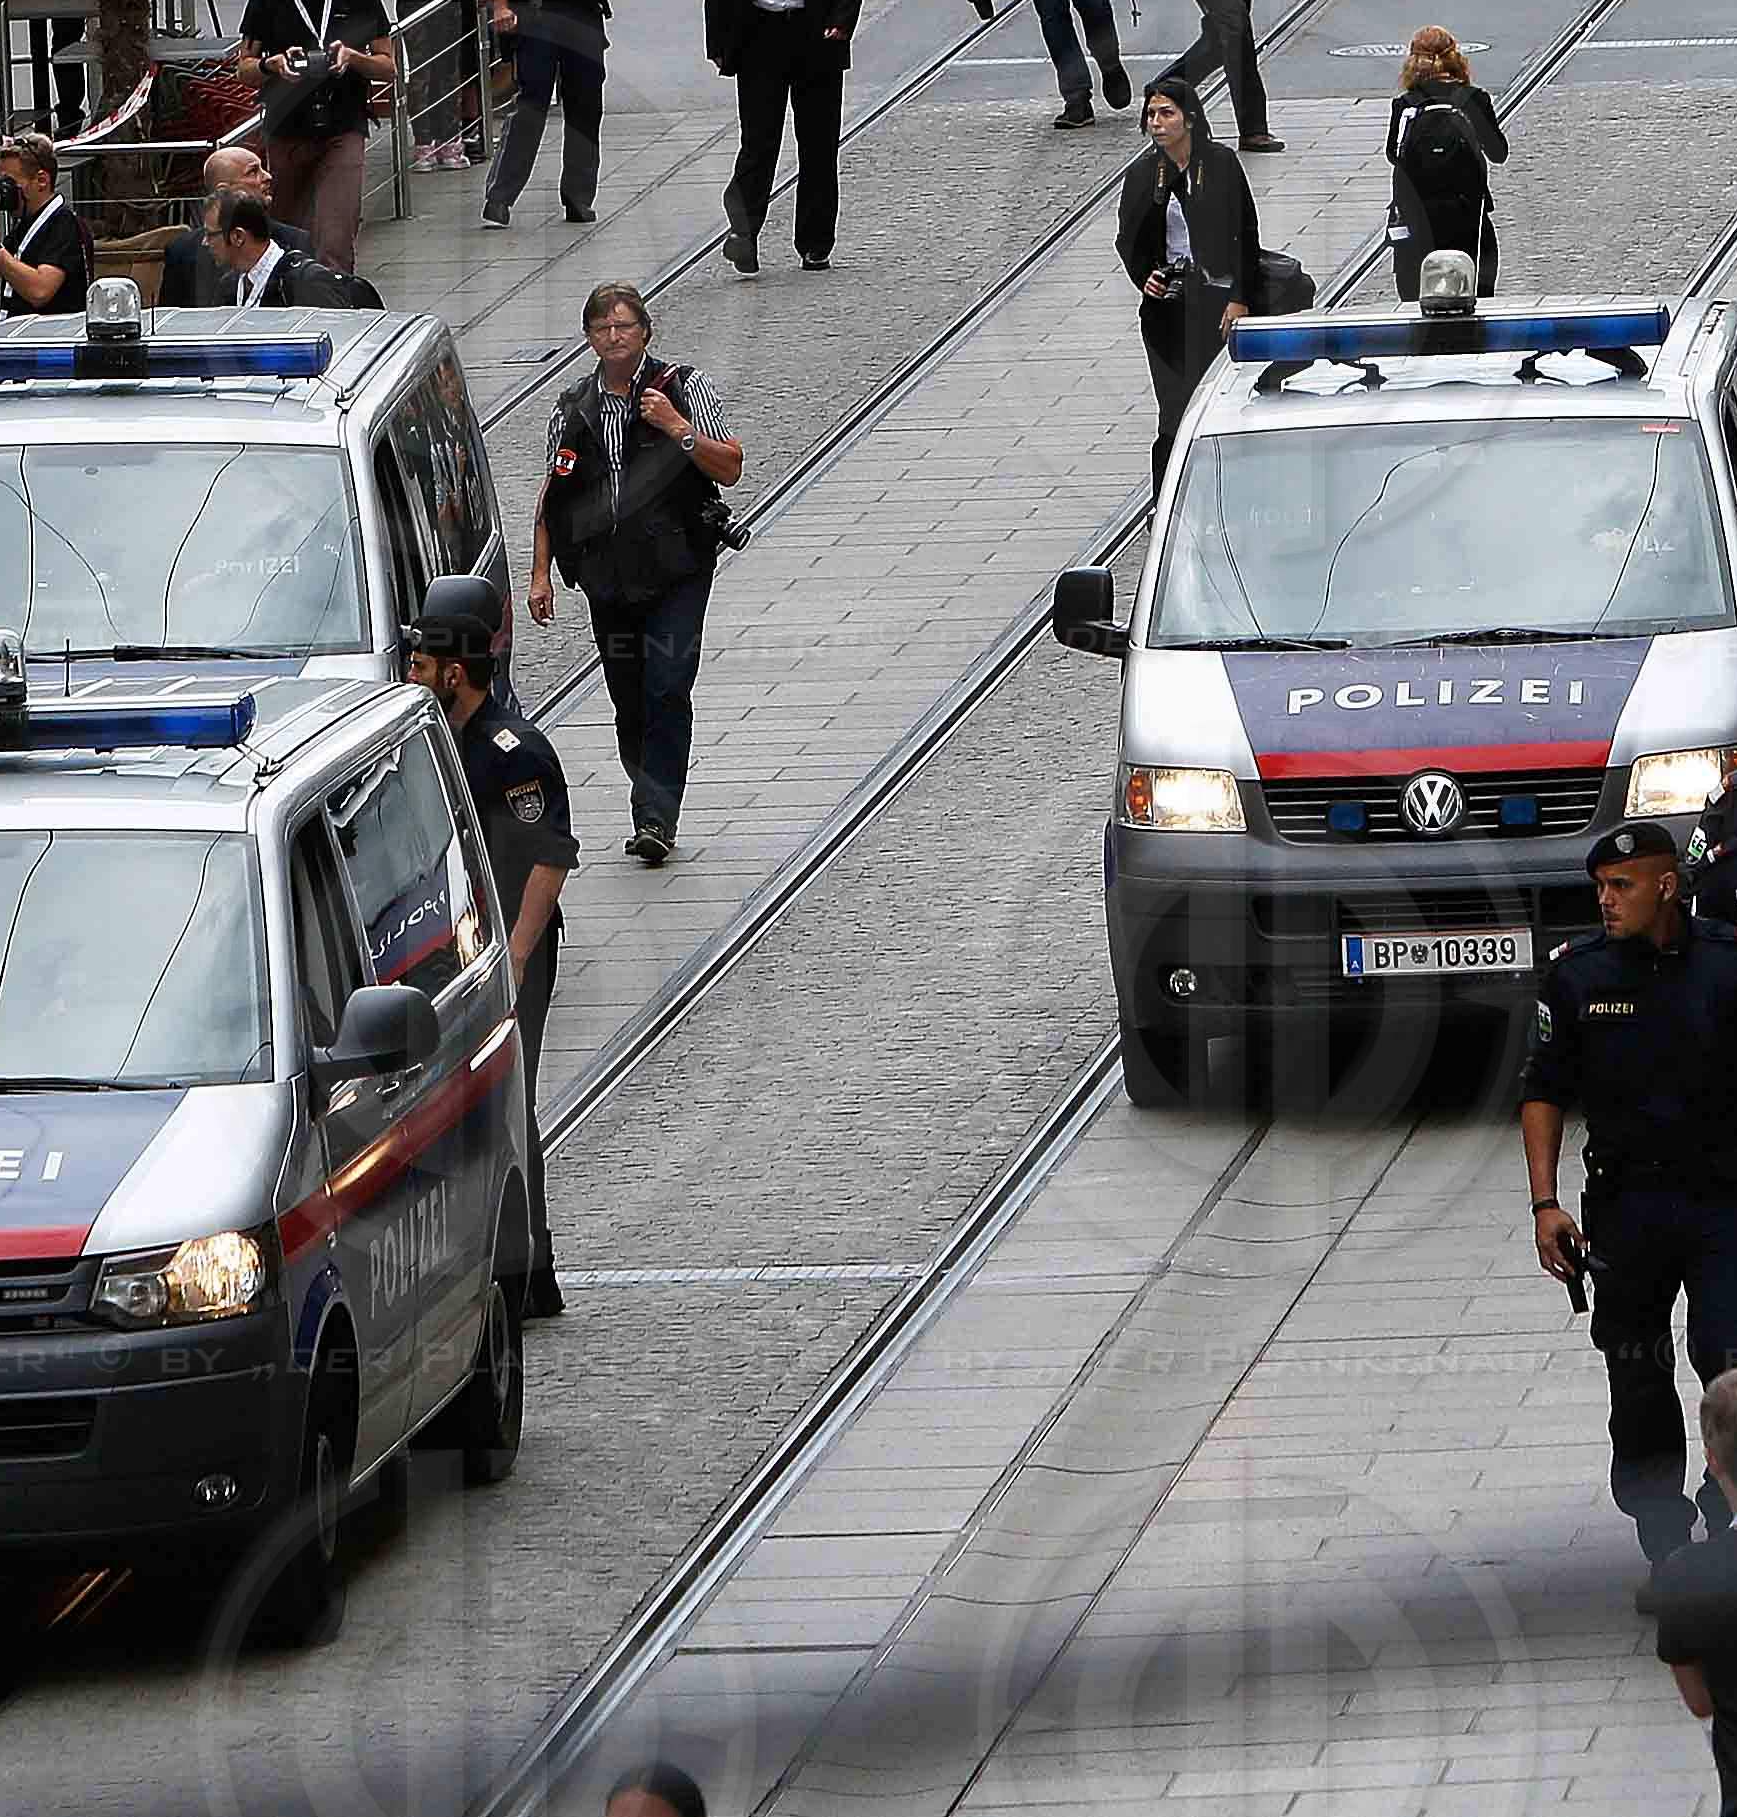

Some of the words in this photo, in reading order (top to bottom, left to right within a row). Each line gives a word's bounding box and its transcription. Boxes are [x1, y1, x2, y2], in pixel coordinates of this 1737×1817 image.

[1287, 679, 1585, 715] POLIZEI
[1373, 941, 1408, 969] BP
[1430, 937, 1517, 968] 10339
[1588, 1002, 1635, 1015] POLIZEI
[368, 1178, 447, 1322] POLIZEI
